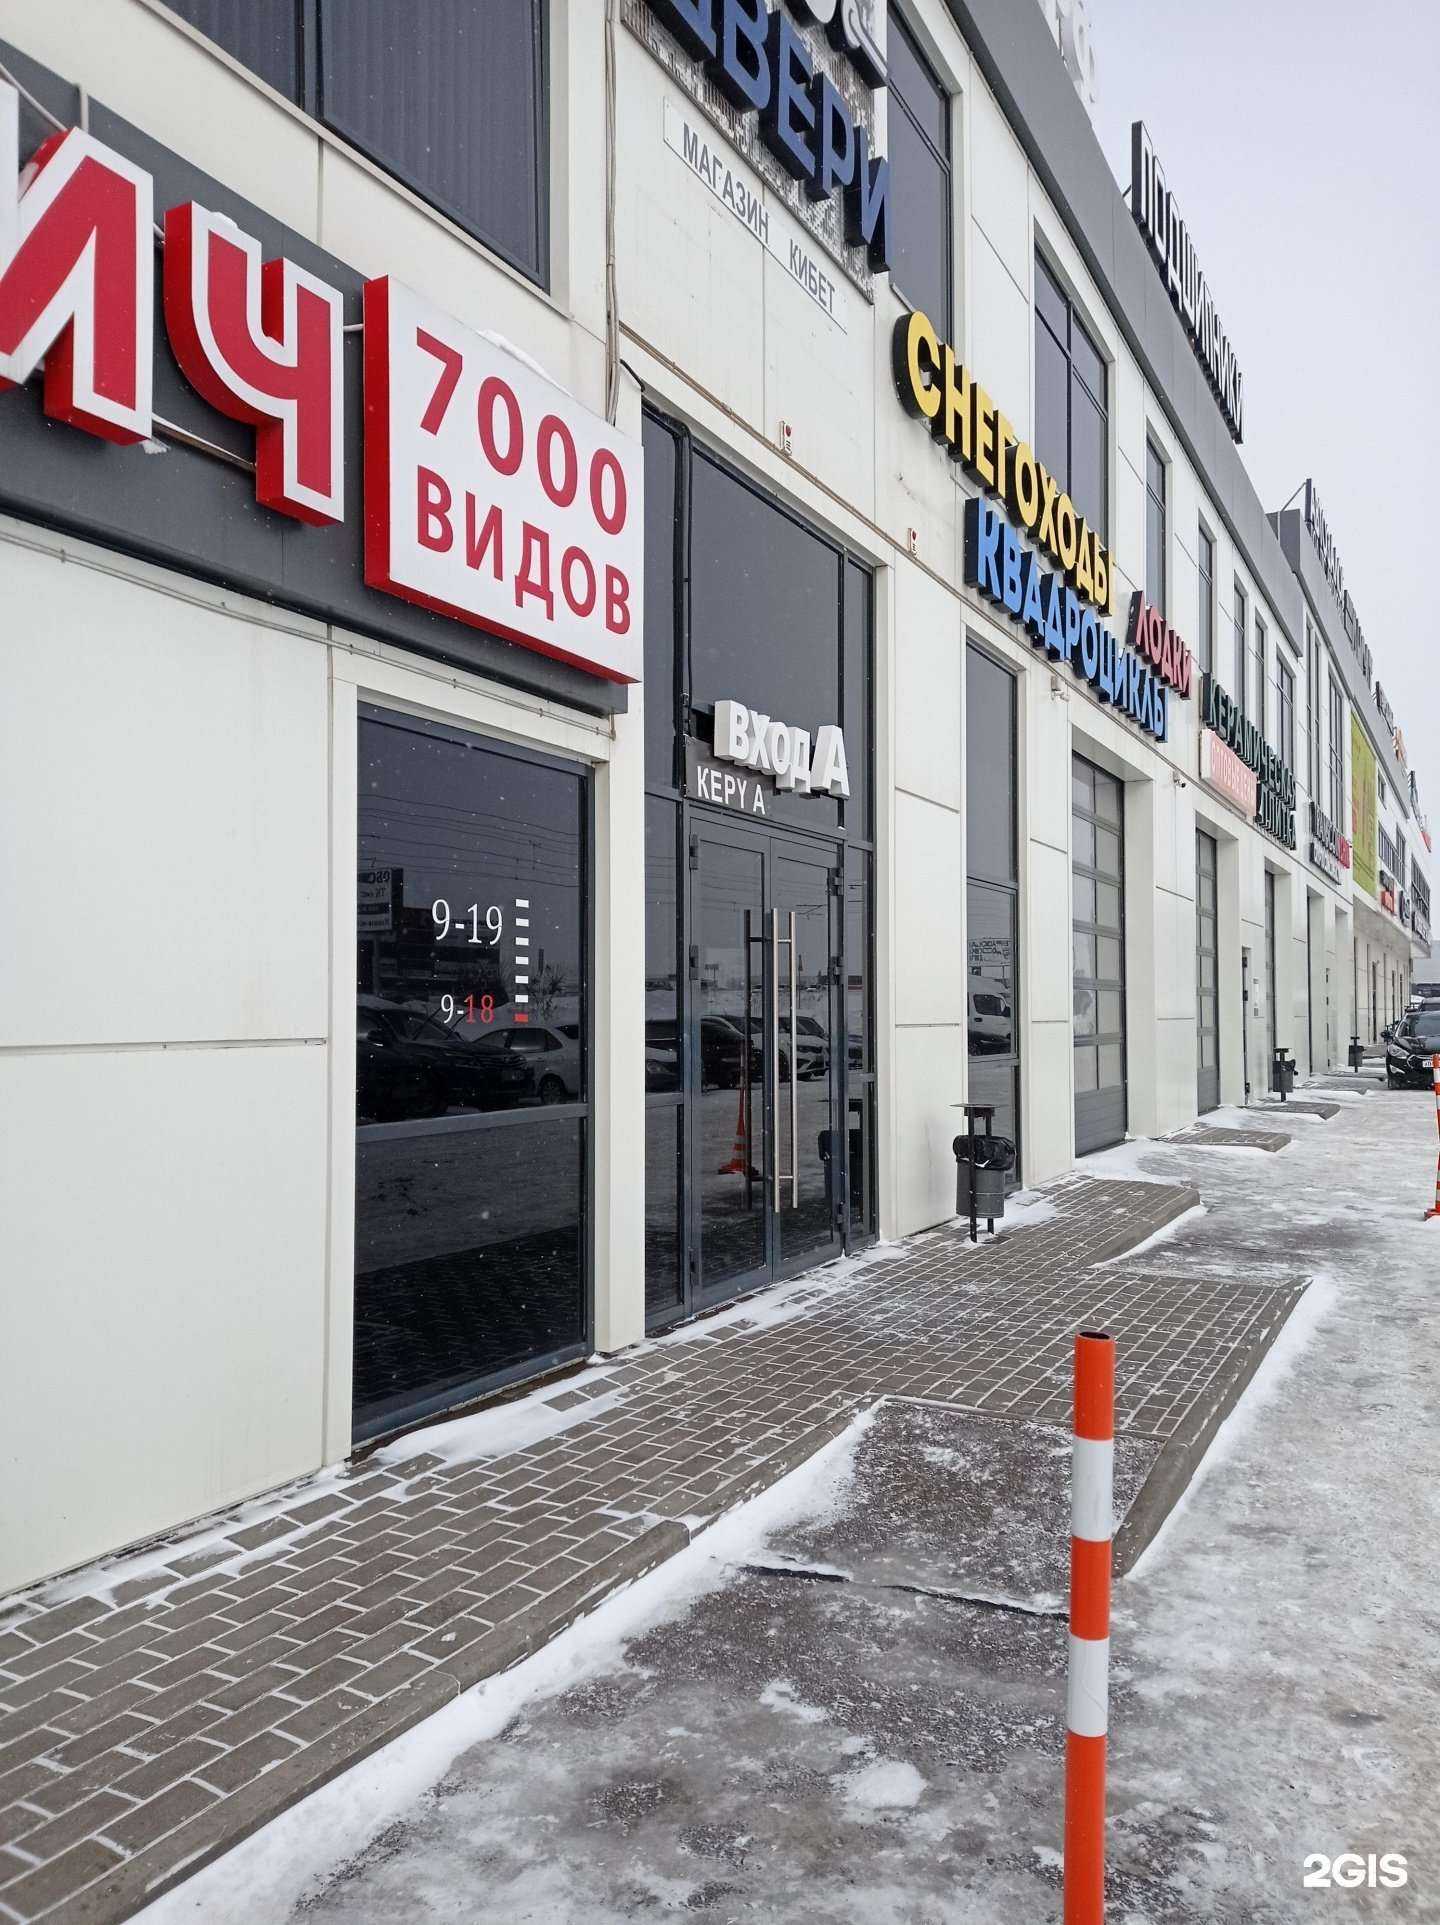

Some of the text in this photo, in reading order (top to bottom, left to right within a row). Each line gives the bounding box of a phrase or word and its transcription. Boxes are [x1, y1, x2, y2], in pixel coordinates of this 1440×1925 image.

[683, 121, 836, 315] МАГАЗИН КИБЕТ
[416, 326, 627, 536] 7000
[902, 311, 1114, 614] СНЕГОХОДЫ
[417, 464, 631, 635] ВИДОВ
[972, 498, 1168, 742] КВАДРОЦИКЛЫ
[1133, 594, 1191, 699] ЛОДКИ
[431, 899, 503, 945] 9-19
[440, 994, 496, 1024] 9-18
